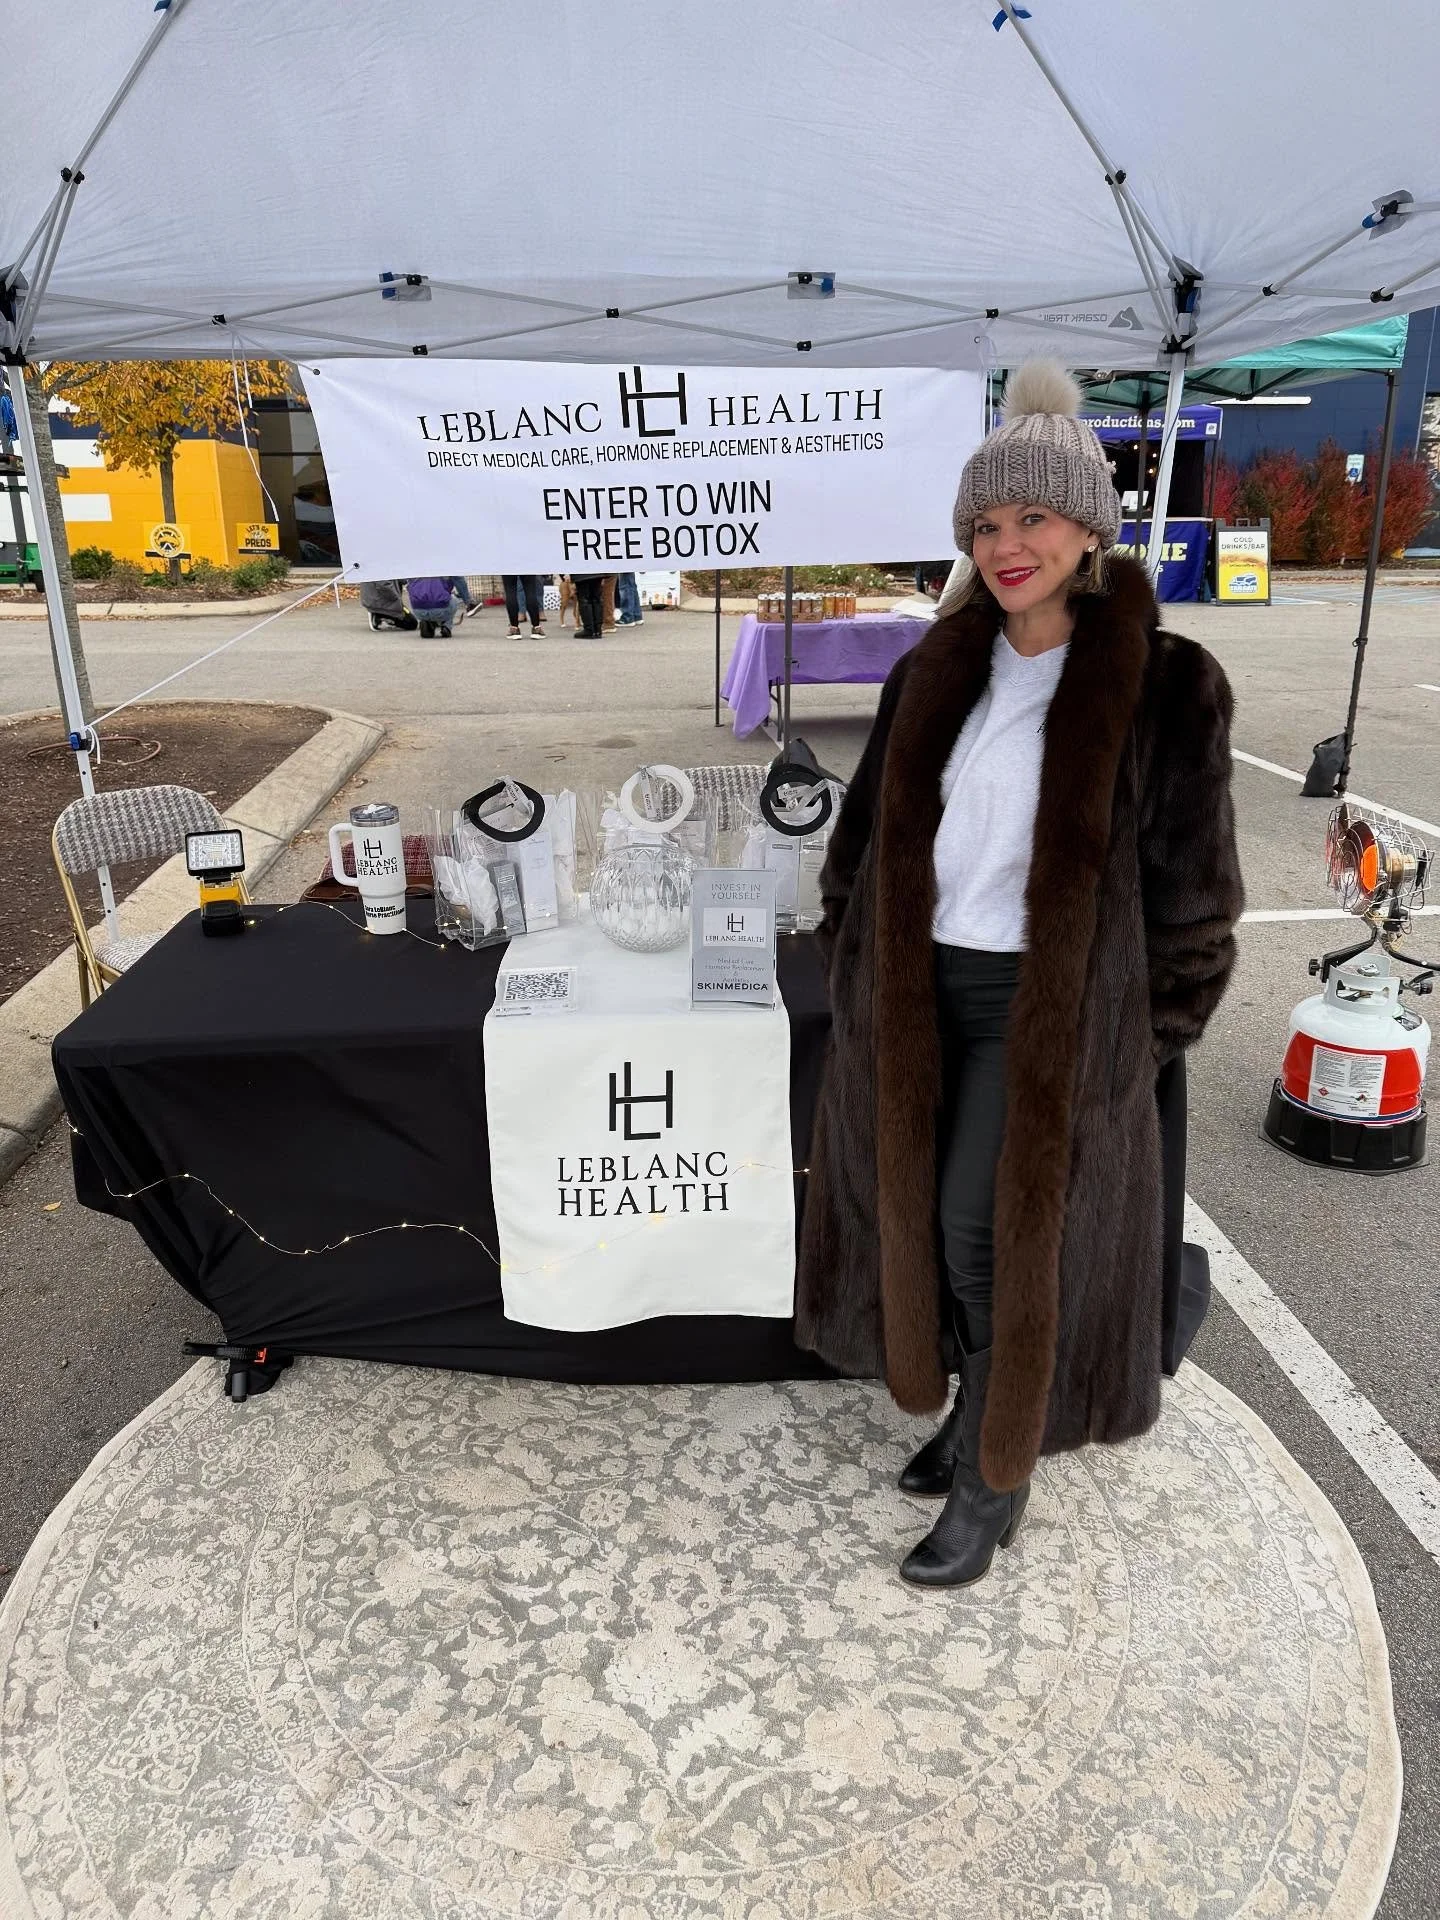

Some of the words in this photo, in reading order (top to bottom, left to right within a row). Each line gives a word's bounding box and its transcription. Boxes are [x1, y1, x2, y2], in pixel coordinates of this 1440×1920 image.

[416, 402, 602, 443] LEBLANC
[707, 388, 884, 427] HEALTH
[428, 451, 479, 468] DIRECT
[483, 451, 549, 468] MEDICAL
[551, 447, 593, 466] CARE,
[596, 442, 670, 463] HORMONE
[673, 437, 778, 459] REPLACEMENT
[781, 437, 792, 454] &
[795, 432, 884, 454] AESTHETICS
[543, 486, 649, 520] ENTER
[656, 483, 698, 517] TO
[706, 480, 771, 514] WIN
[245, 538, 271, 547] PREDS
[562, 527, 644, 560] FREE
[652, 522, 760, 559] BOTOX
[357, 857, 397, 867] LEBLANC
[358, 865, 398, 876] HEALTH
[711, 883, 746, 891] INVEST
[750, 883, 761, 892] IN
[711, 892, 761, 900] YOURSELF
[738, 935, 765, 943] HEALTH
[697, 982, 769, 991] SKINMEDICA
[558, 1151, 728, 1183] LEBLANC
[558, 1182, 729, 1217] HEALTH
